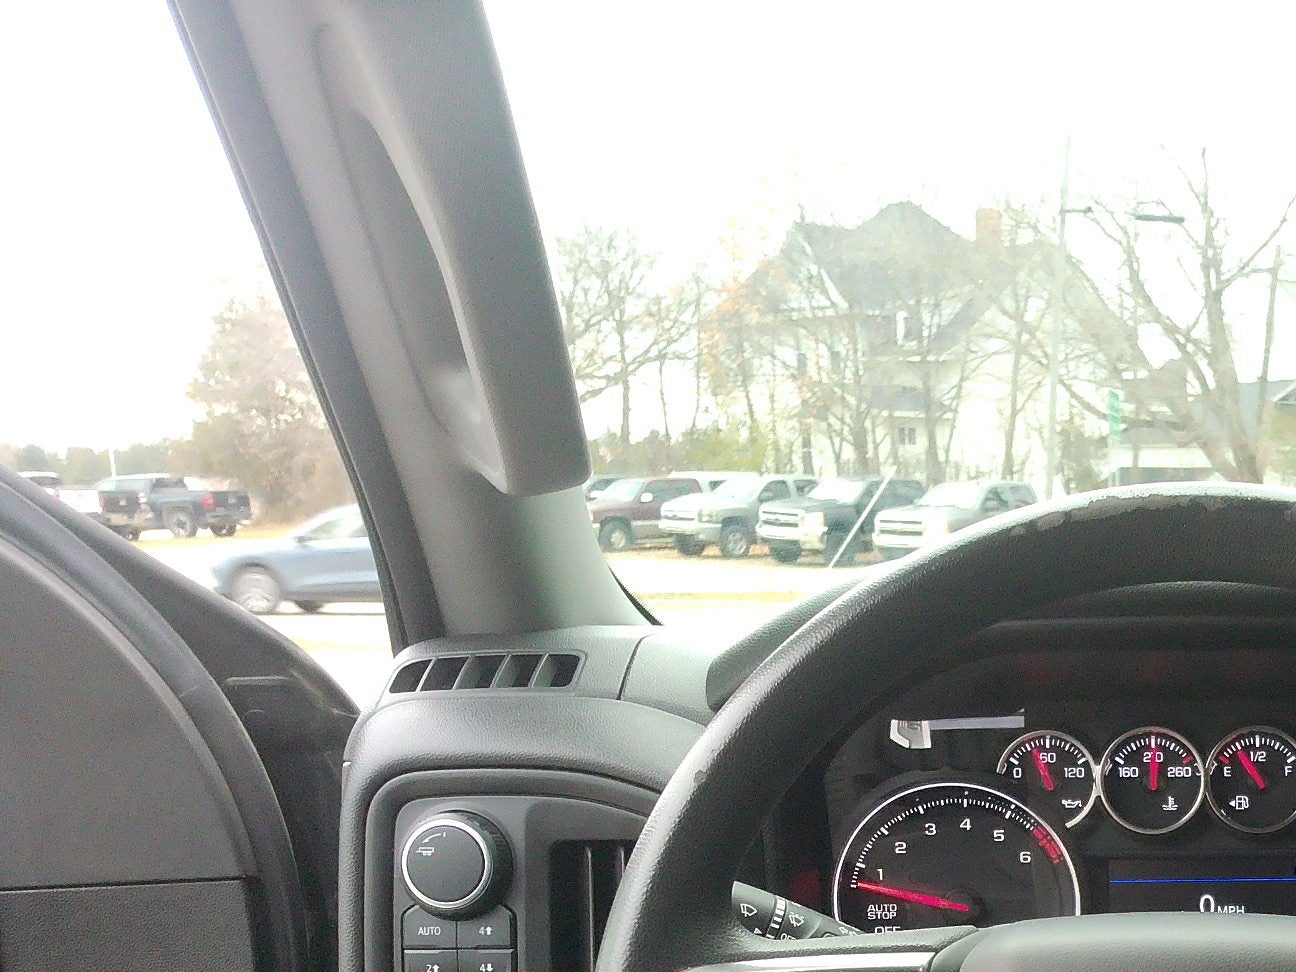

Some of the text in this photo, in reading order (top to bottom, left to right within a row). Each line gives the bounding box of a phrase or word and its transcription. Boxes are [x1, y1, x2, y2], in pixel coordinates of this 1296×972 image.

[1039, 752, 1056, 764] 60
[1250, 751, 1266, 763] 1/2
[1013, 767, 1022, 779] 0
[1064, 767, 1085, 779] 120
[1118, 766, 1139, 778] 160
[1167, 766, 1192, 778] 260
[1223, 766, 1232, 777] E
[1284, 766, 1293, 777] F
[924, 822, 937, 836] 3
[960, 818, 972, 831] 4
[993, 829, 1005, 842] 5
[894, 841, 907, 854] 2
[1019, 851, 1032, 864] 6
[876, 868, 884, 881] 1
[867, 904, 897, 912] AUTO
[1217, 905, 1245, 914] MPH
[867, 911, 897, 920] STOP
[418, 925, 442, 936] AUTO
